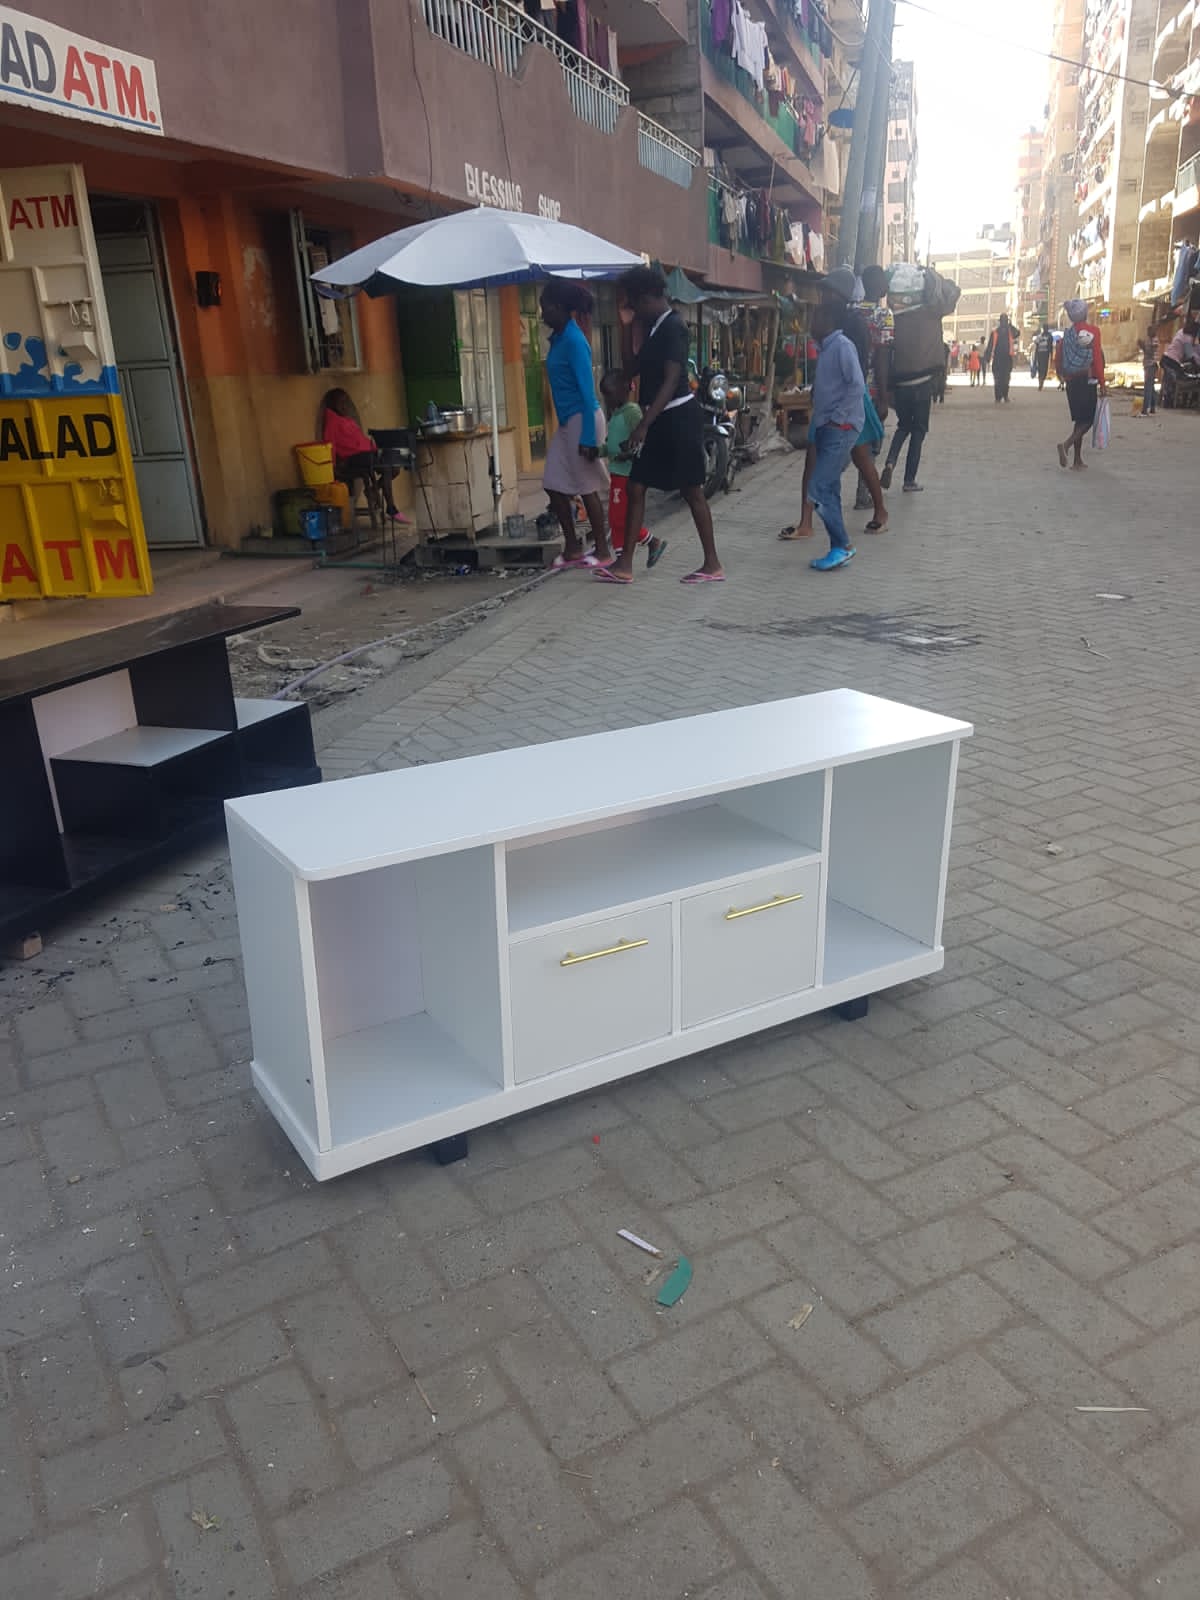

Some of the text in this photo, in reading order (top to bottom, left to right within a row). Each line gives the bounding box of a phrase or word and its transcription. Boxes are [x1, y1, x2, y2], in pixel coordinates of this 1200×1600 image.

[1, 22, 157, 123] AD ATM.
[9, 194, 79, 231] ATM
[464, 162, 561, 221] BLESSING SHOP
[0, 413, 117, 461] ALAD
[2, 538, 140, 583] ATM
